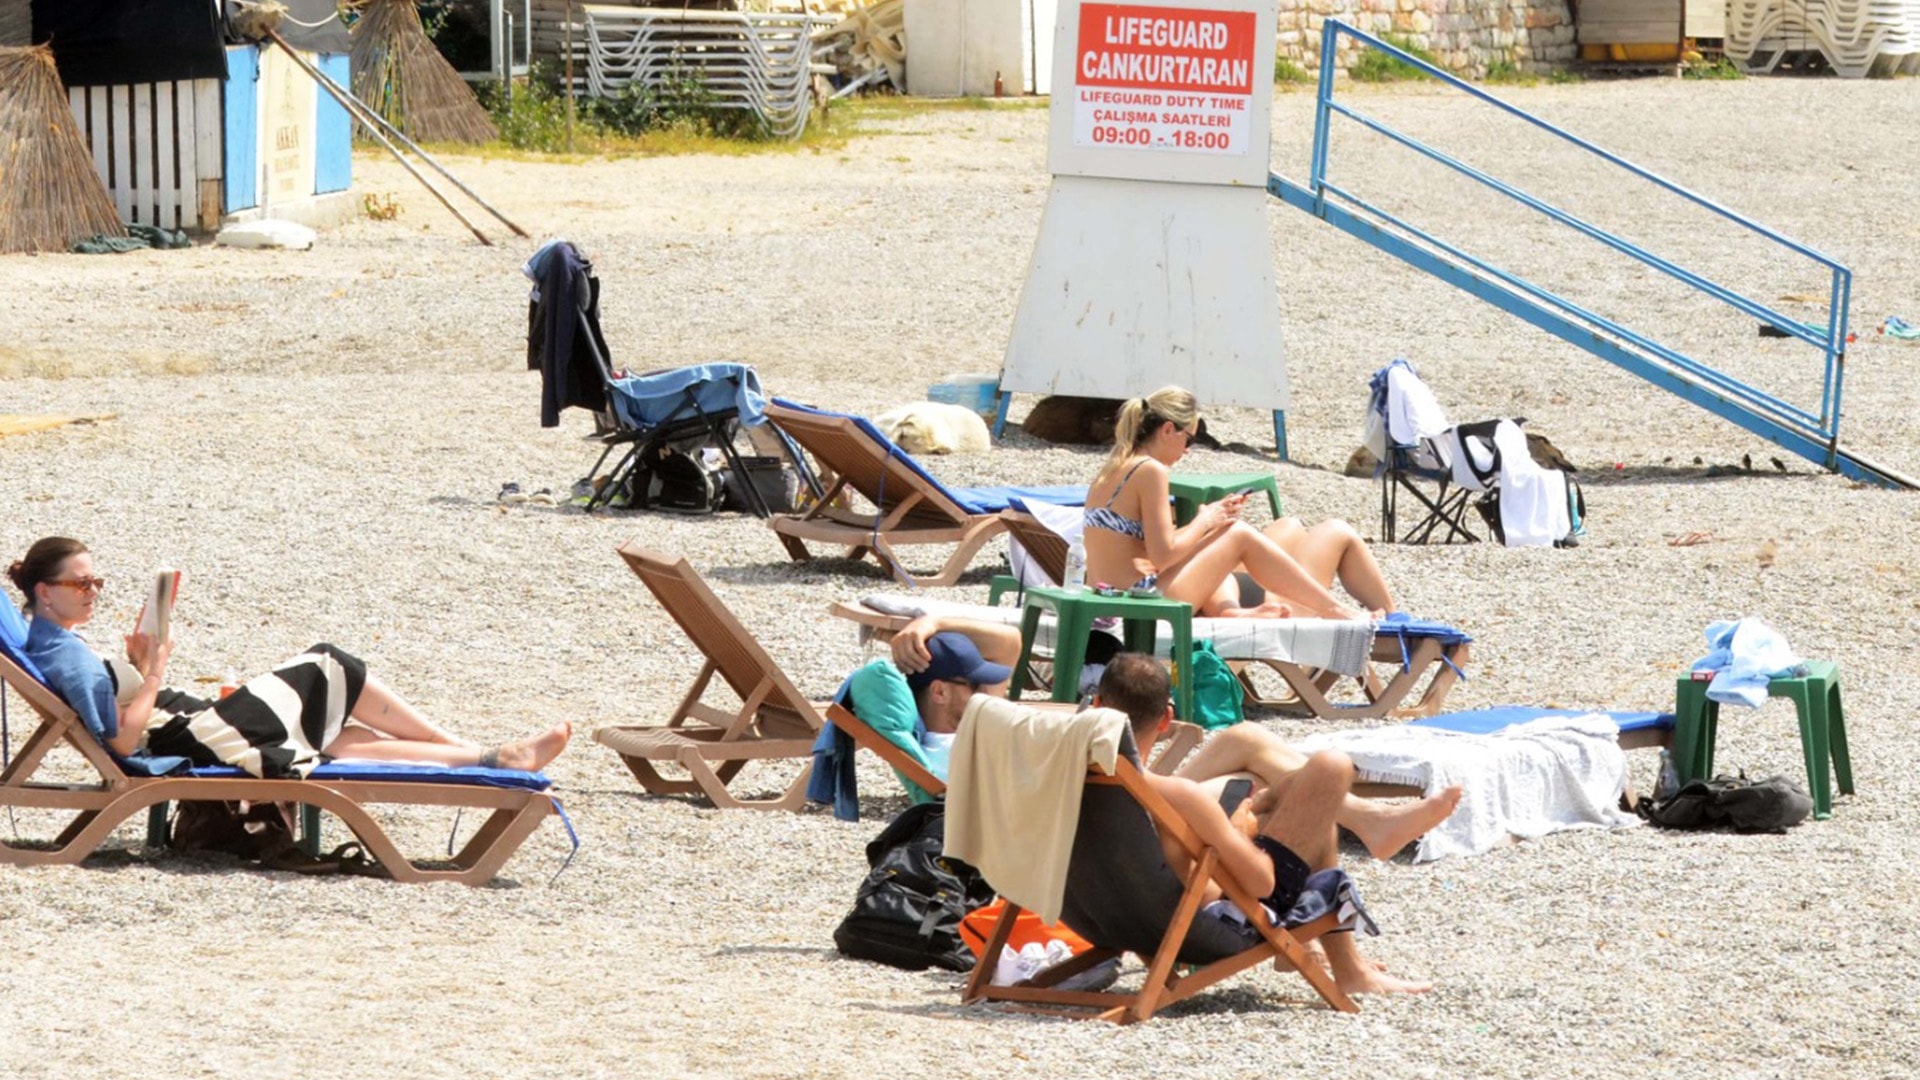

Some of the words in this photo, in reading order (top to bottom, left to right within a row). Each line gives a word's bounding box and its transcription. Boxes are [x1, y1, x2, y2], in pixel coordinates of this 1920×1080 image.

[1105, 16, 1228, 50] LIFEGUARD
[1082, 50, 1248, 87] CANKURTARAN
[1080, 91, 1162, 106] LIFEGUARD
[1166, 95, 1206, 108] DUTY
[1210, 97, 1245, 110] TIME
[1093, 109, 1157, 125] ÇALIŞMA
[1162, 112, 1231, 127] SAATLERİ
[1092, 126, 1151, 145] 09:00
[1171, 130, 1230, 149] 18:00
